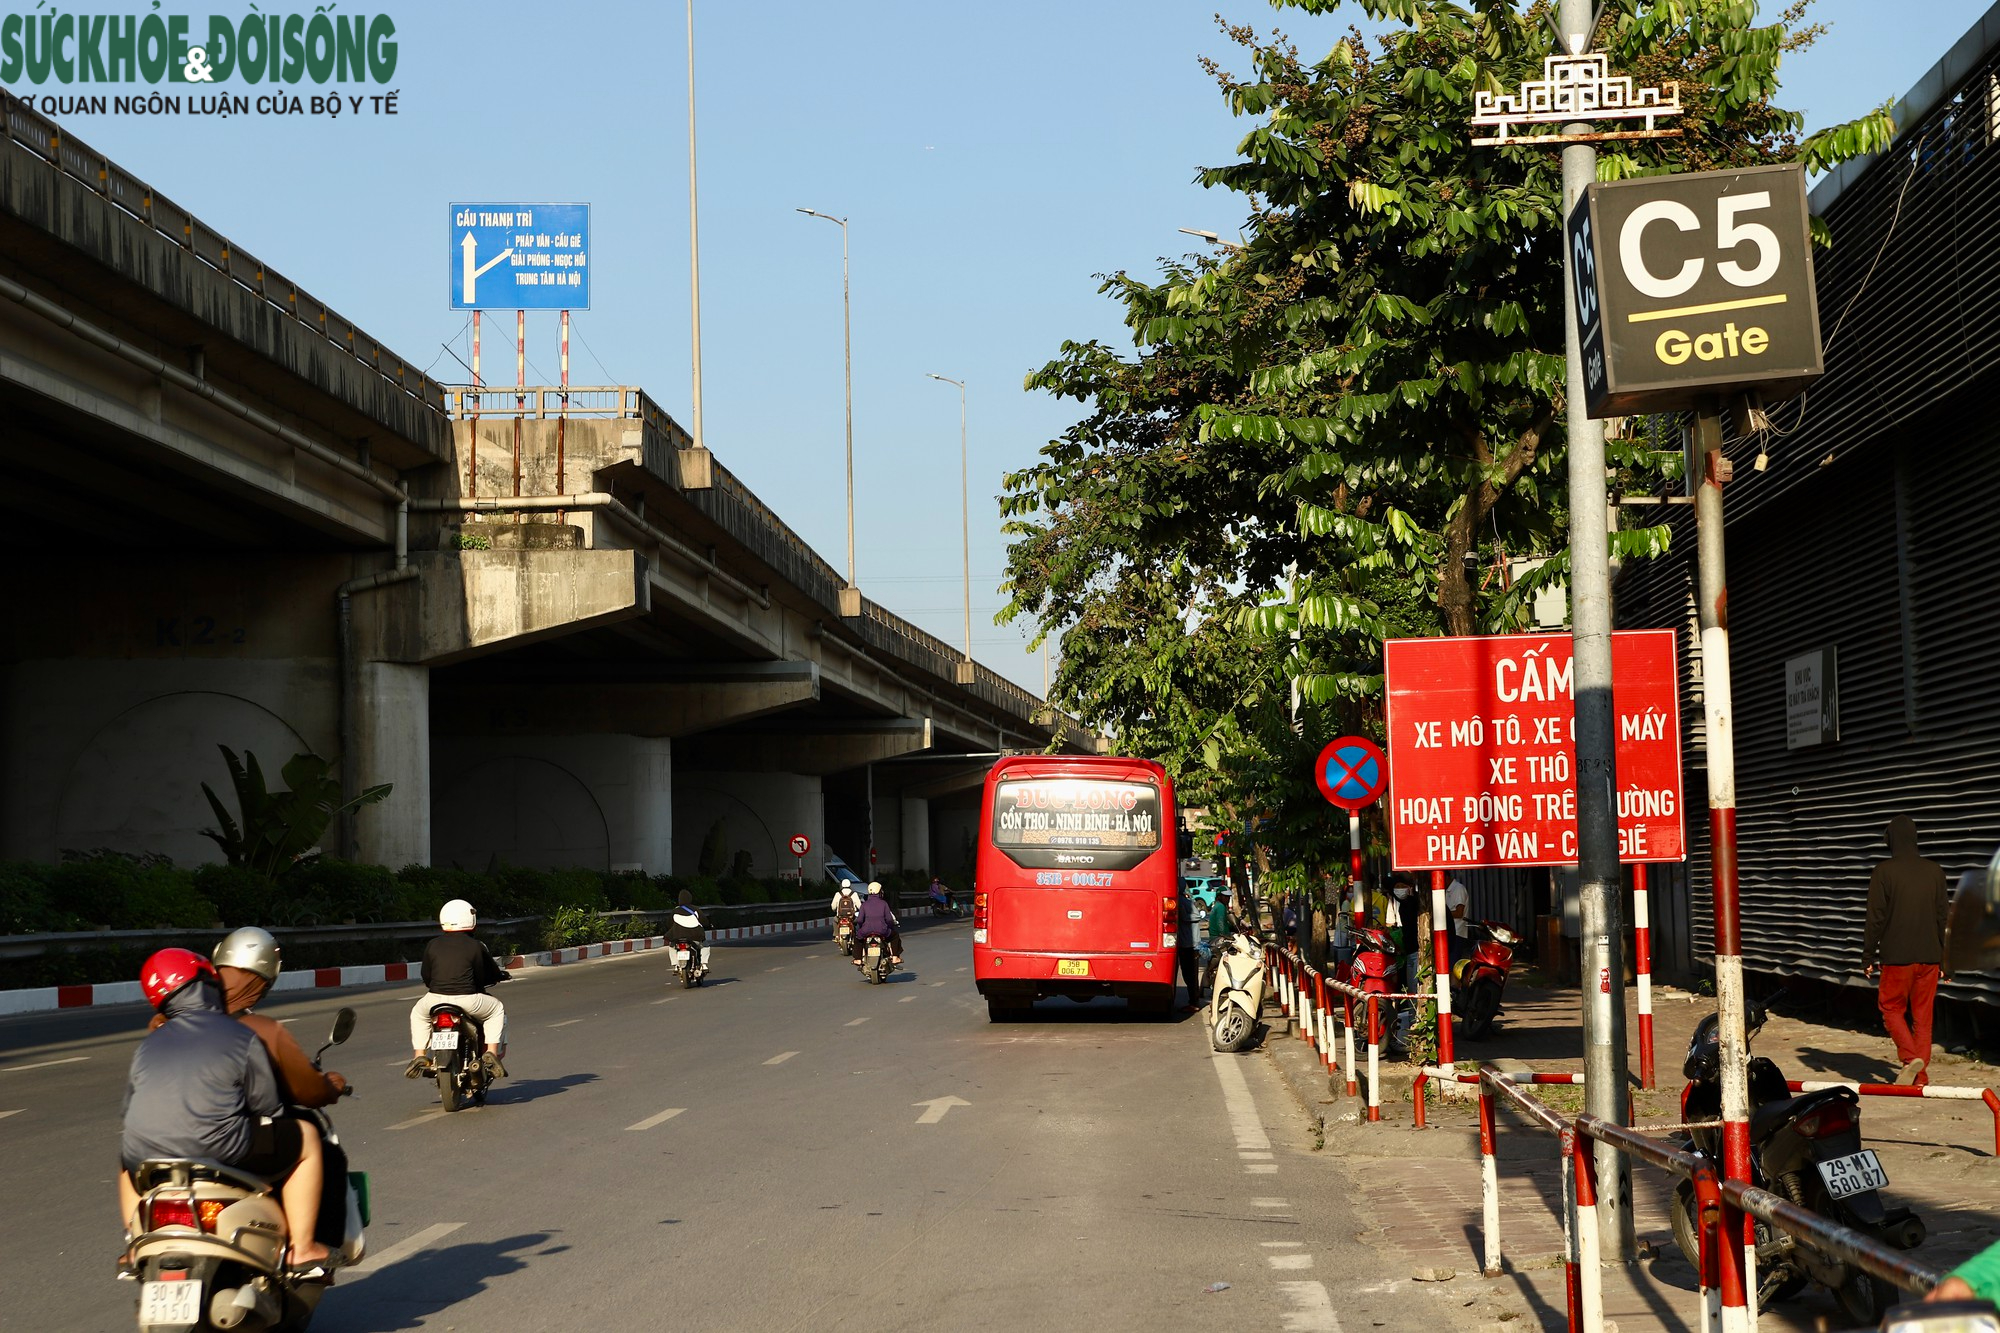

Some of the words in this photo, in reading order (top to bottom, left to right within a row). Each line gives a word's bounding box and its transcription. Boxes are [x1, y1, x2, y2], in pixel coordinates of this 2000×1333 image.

[479, 212, 513, 227] THANH
[516, 210, 533, 227] TRÌ
[515, 233, 535, 248] PHÁP
[536, 233, 550, 248] VÂN
[1619, 191, 1781, 298] C5
[511, 250, 525, 266] GIẢI
[527, 252, 550, 266] PHÓNG
[554, 253, 573, 269] NGỌC
[1574, 216, 1597, 326] C5
[516, 273, 538, 286] TRUNG
[540, 271, 555, 286] TÂM
[557, 271, 567, 286] HÀ
[568, 271, 581, 288] NỘI
[1655, 322, 1769, 365] Gate
[1496, 643, 1575, 702] CẤM
[1414, 721, 1442, 748] XE
[1451, 715, 1484, 747] MÔ
[1492, 713, 1527, 746] TÔ,
[1533, 717, 1562, 745] XE
[1621, 706, 1667, 741] MÁY
[1490, 758, 1518, 784] XE
[1526, 750, 1569, 784] THÔ
[1073, 789, 1137, 810] LONG
[1400, 797, 1453, 830] HOẠT
[1463, 791, 1523, 827] ĐỘNG
[1532, 788, 1576, 821] TRÊ
[1616, 783, 1675, 819] ƯỜNG
[1056, 813, 1083, 831] NINH
[1085, 809, 1110, 832] BÌNH
[1115, 810, 1130, 832] HÀ
[1133, 809, 1152, 835] NỘI
[1427, 827, 1485, 862] PHÁP
[1495, 828, 1538, 859] VÂN
[1036, 872, 1062, 886] 35B
[1826, 1153, 1872, 1178] 29-M1
[1829, 1168, 1881, 1196] 580.87
